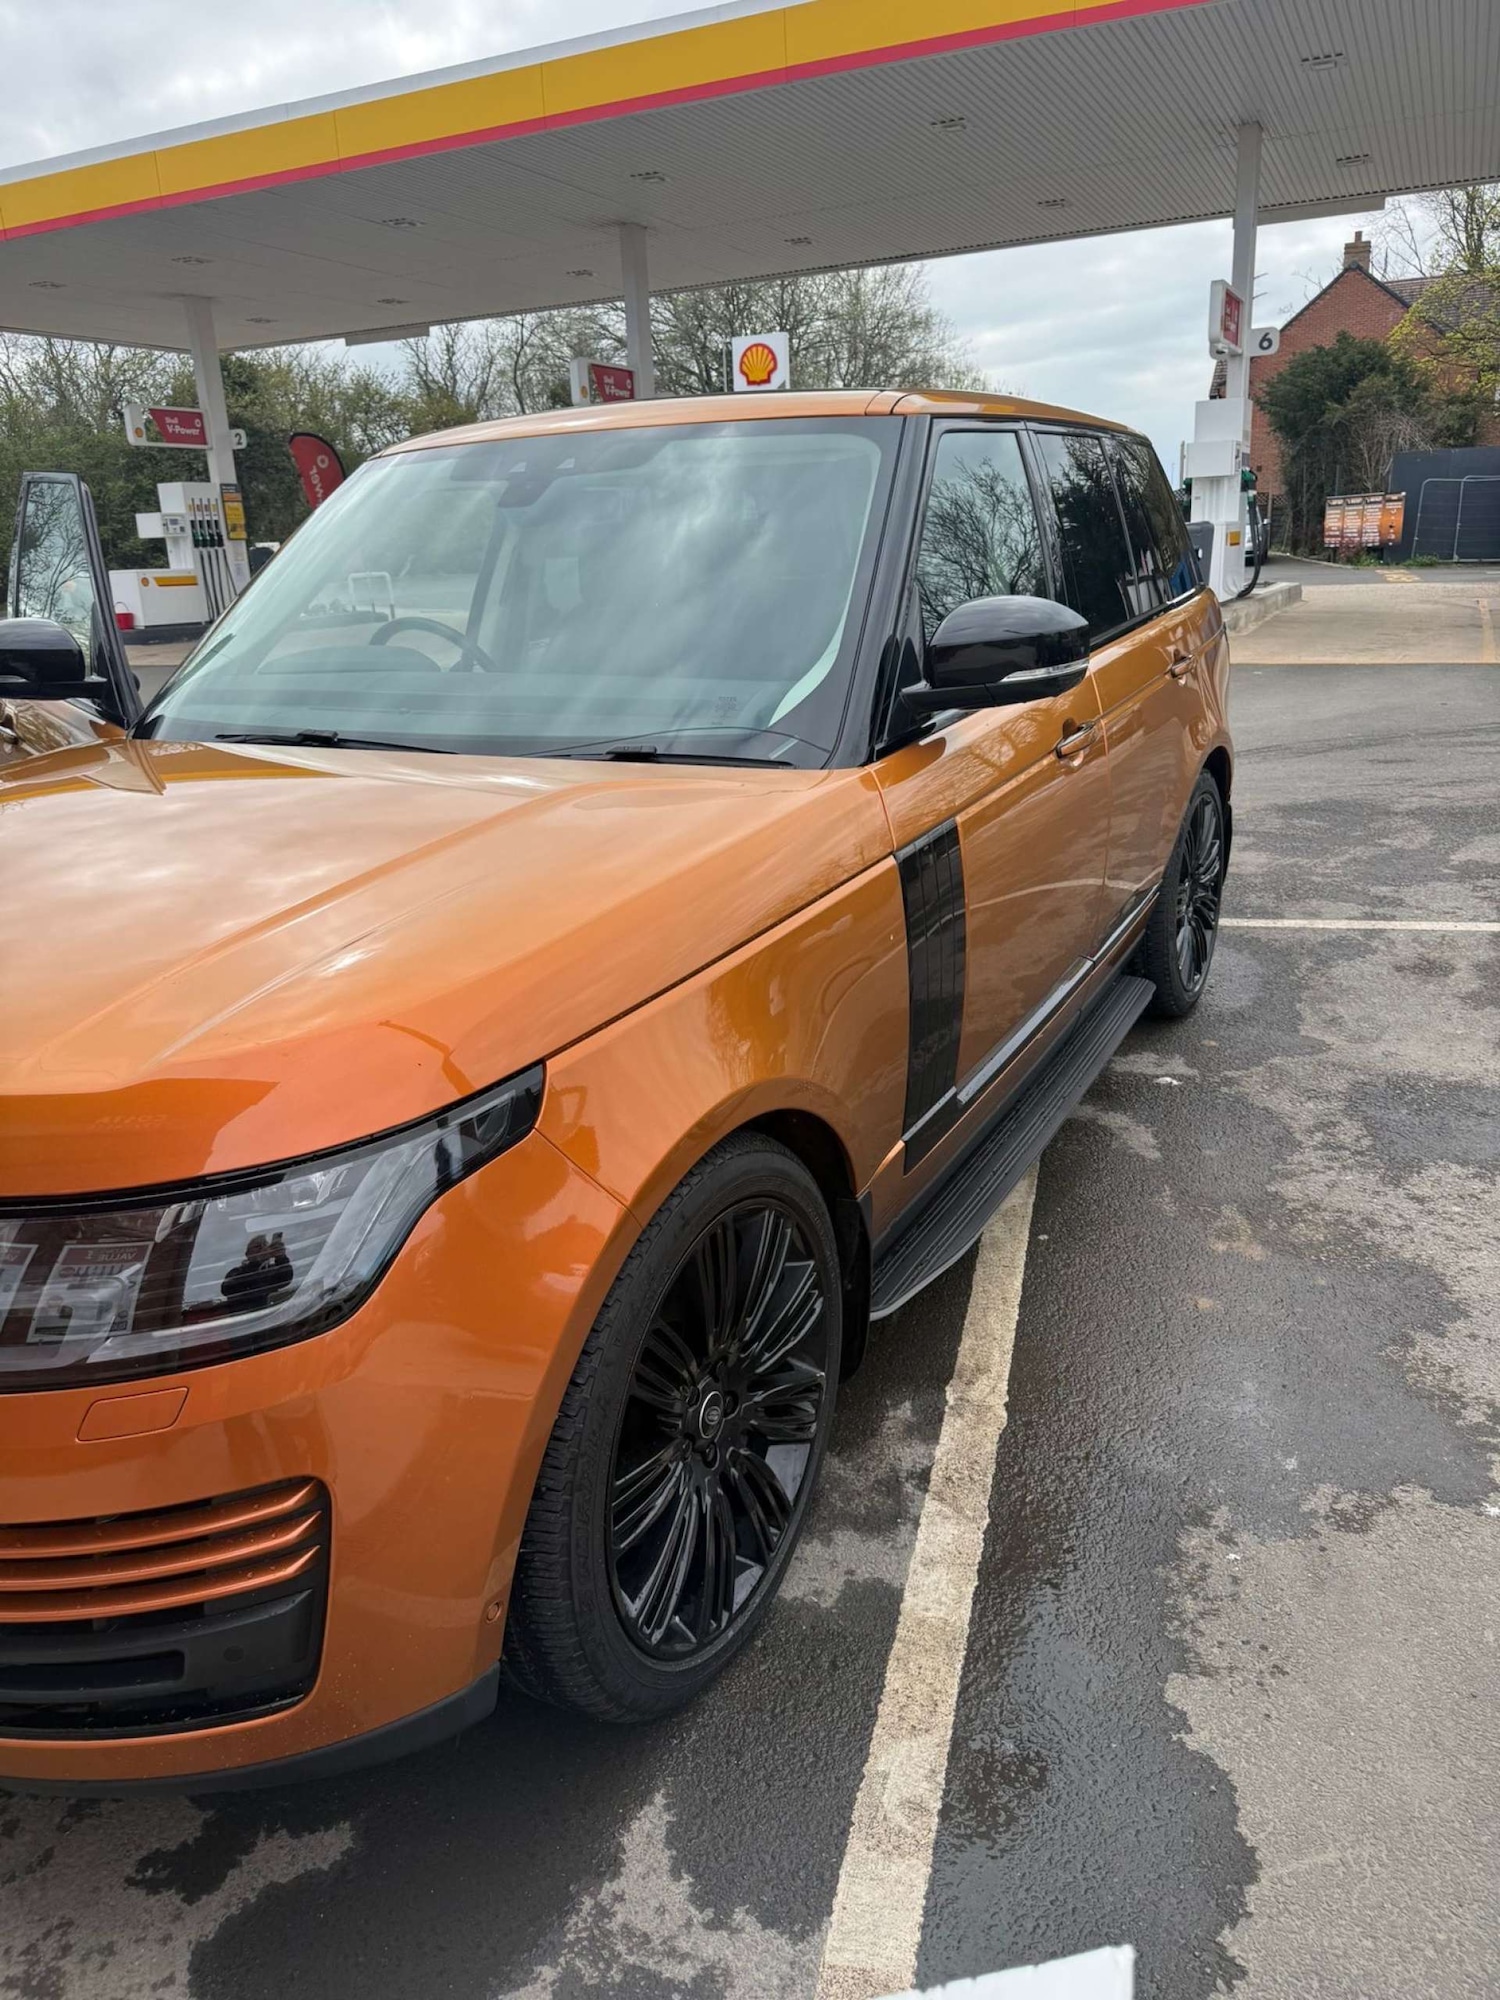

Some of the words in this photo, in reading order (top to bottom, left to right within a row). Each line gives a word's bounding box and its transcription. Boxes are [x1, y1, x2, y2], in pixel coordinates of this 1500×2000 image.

[1259, 332, 1273, 351] 6
[166, 425, 200, 436] V-Power
[234, 432, 243, 446] 2
